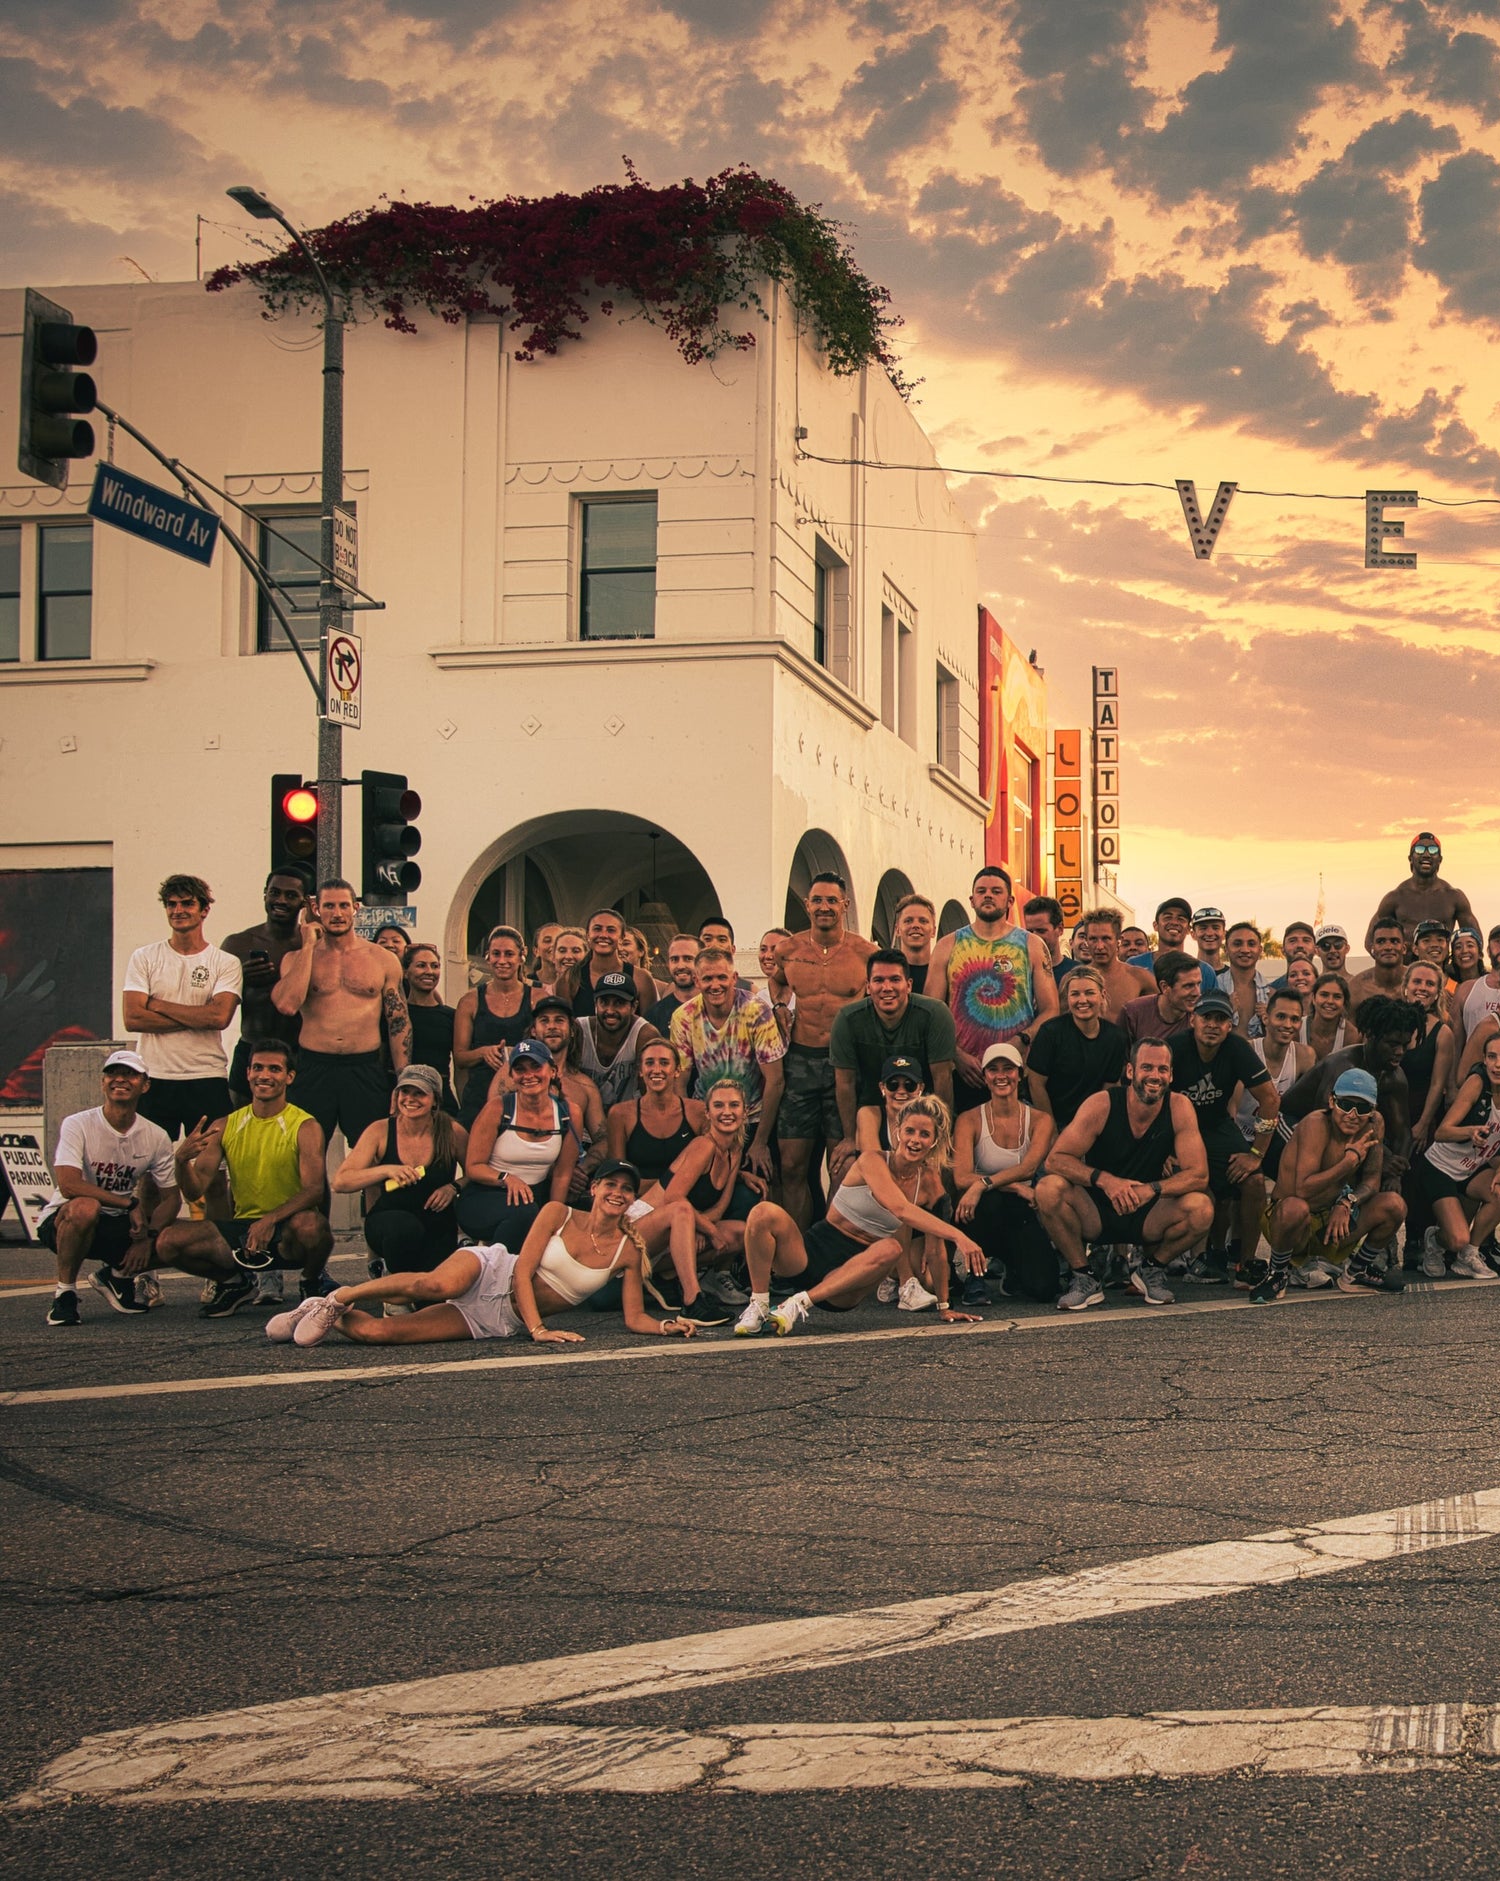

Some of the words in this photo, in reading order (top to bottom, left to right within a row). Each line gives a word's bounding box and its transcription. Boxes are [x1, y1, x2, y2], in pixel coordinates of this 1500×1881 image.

[101, 476, 187, 538] Windward
[186, 518, 210, 548] Av
[330, 697, 341, 715] ON
[343, 702, 359, 719] RED
[1100, 671, 1115, 857] TATTOO
[3, 1150, 43, 1166] PUBLIC
[1460, 1157, 1478, 1171] RUN
[8, 1170, 52, 1187] PARKING
